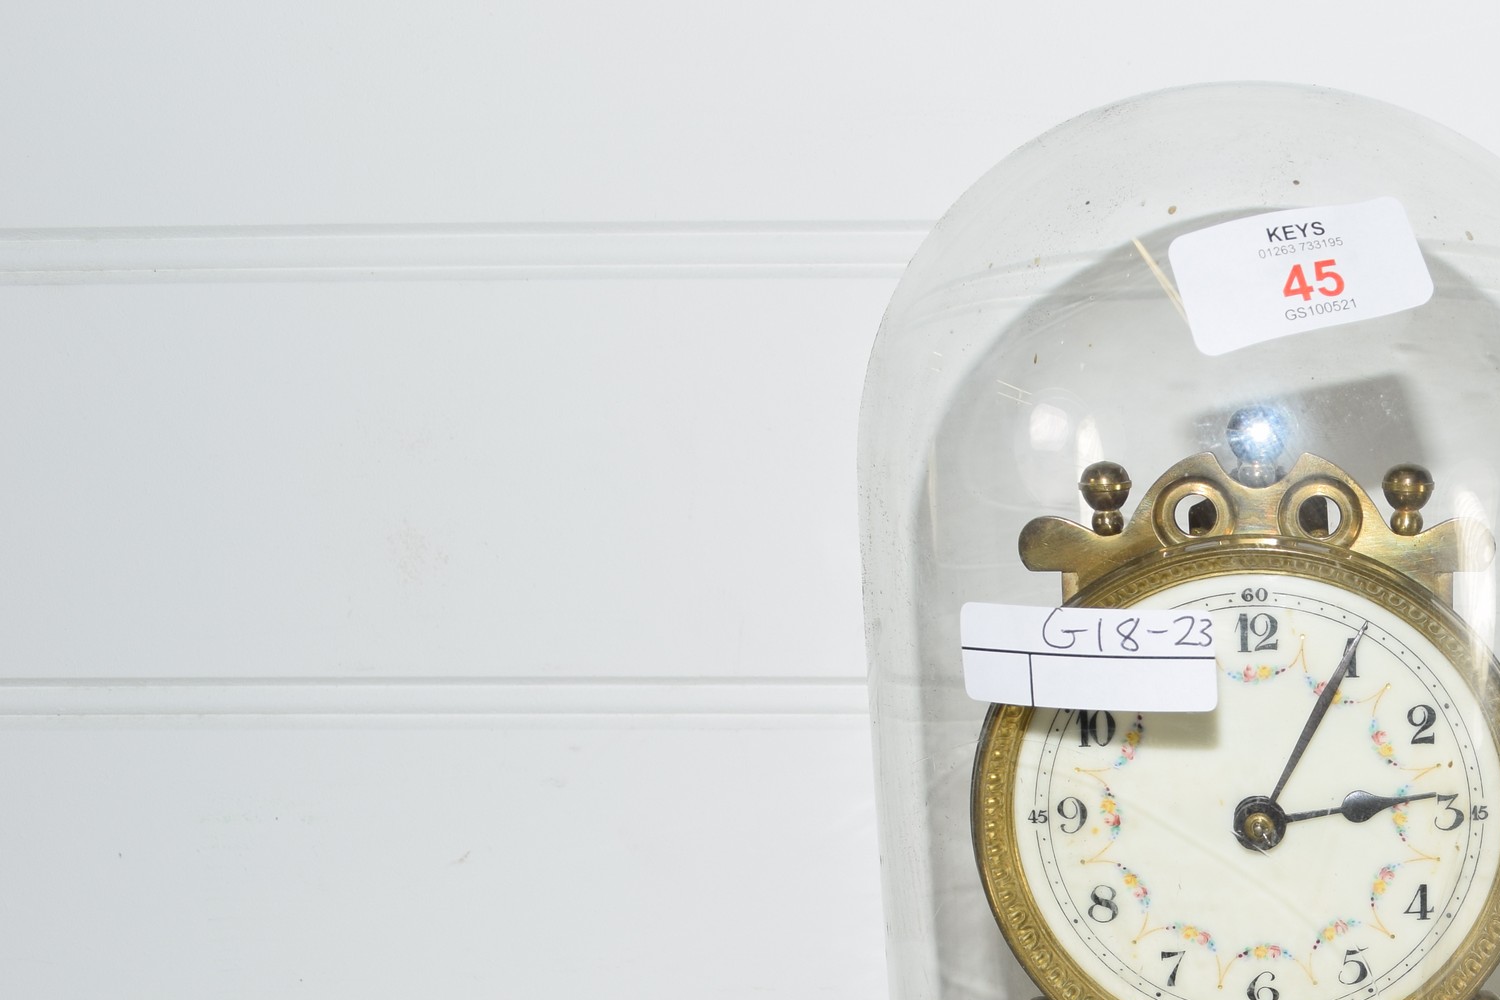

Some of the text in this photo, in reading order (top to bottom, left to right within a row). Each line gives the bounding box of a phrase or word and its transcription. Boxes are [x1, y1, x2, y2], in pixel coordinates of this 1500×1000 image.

[1258, 237, 1344, 259] 01263 733195
[1266, 221, 1326, 242] KEYS
[1282, 259, 1345, 302] 45
[1284, 298, 1357, 321] GS100521
[1241, 588, 1268, 602] 60
[1042, 607, 1212, 652] G18-23
[1234, 612, 1278, 653] 12
[1075, 710, 1116, 747] 10
[1407, 703, 1436, 744] 2
[1027, 810, 1049, 824] 45
[1056, 796, 1088, 833] 9
[1434, 793, 1464, 831] 3
[1470, 806, 1489, 820] 15
[1088, 885, 1119, 923] 8
[1404, 884, 1435, 920] 4
[1161, 950, 1187, 986] 7
[1338, 946, 1368, 984] 5
